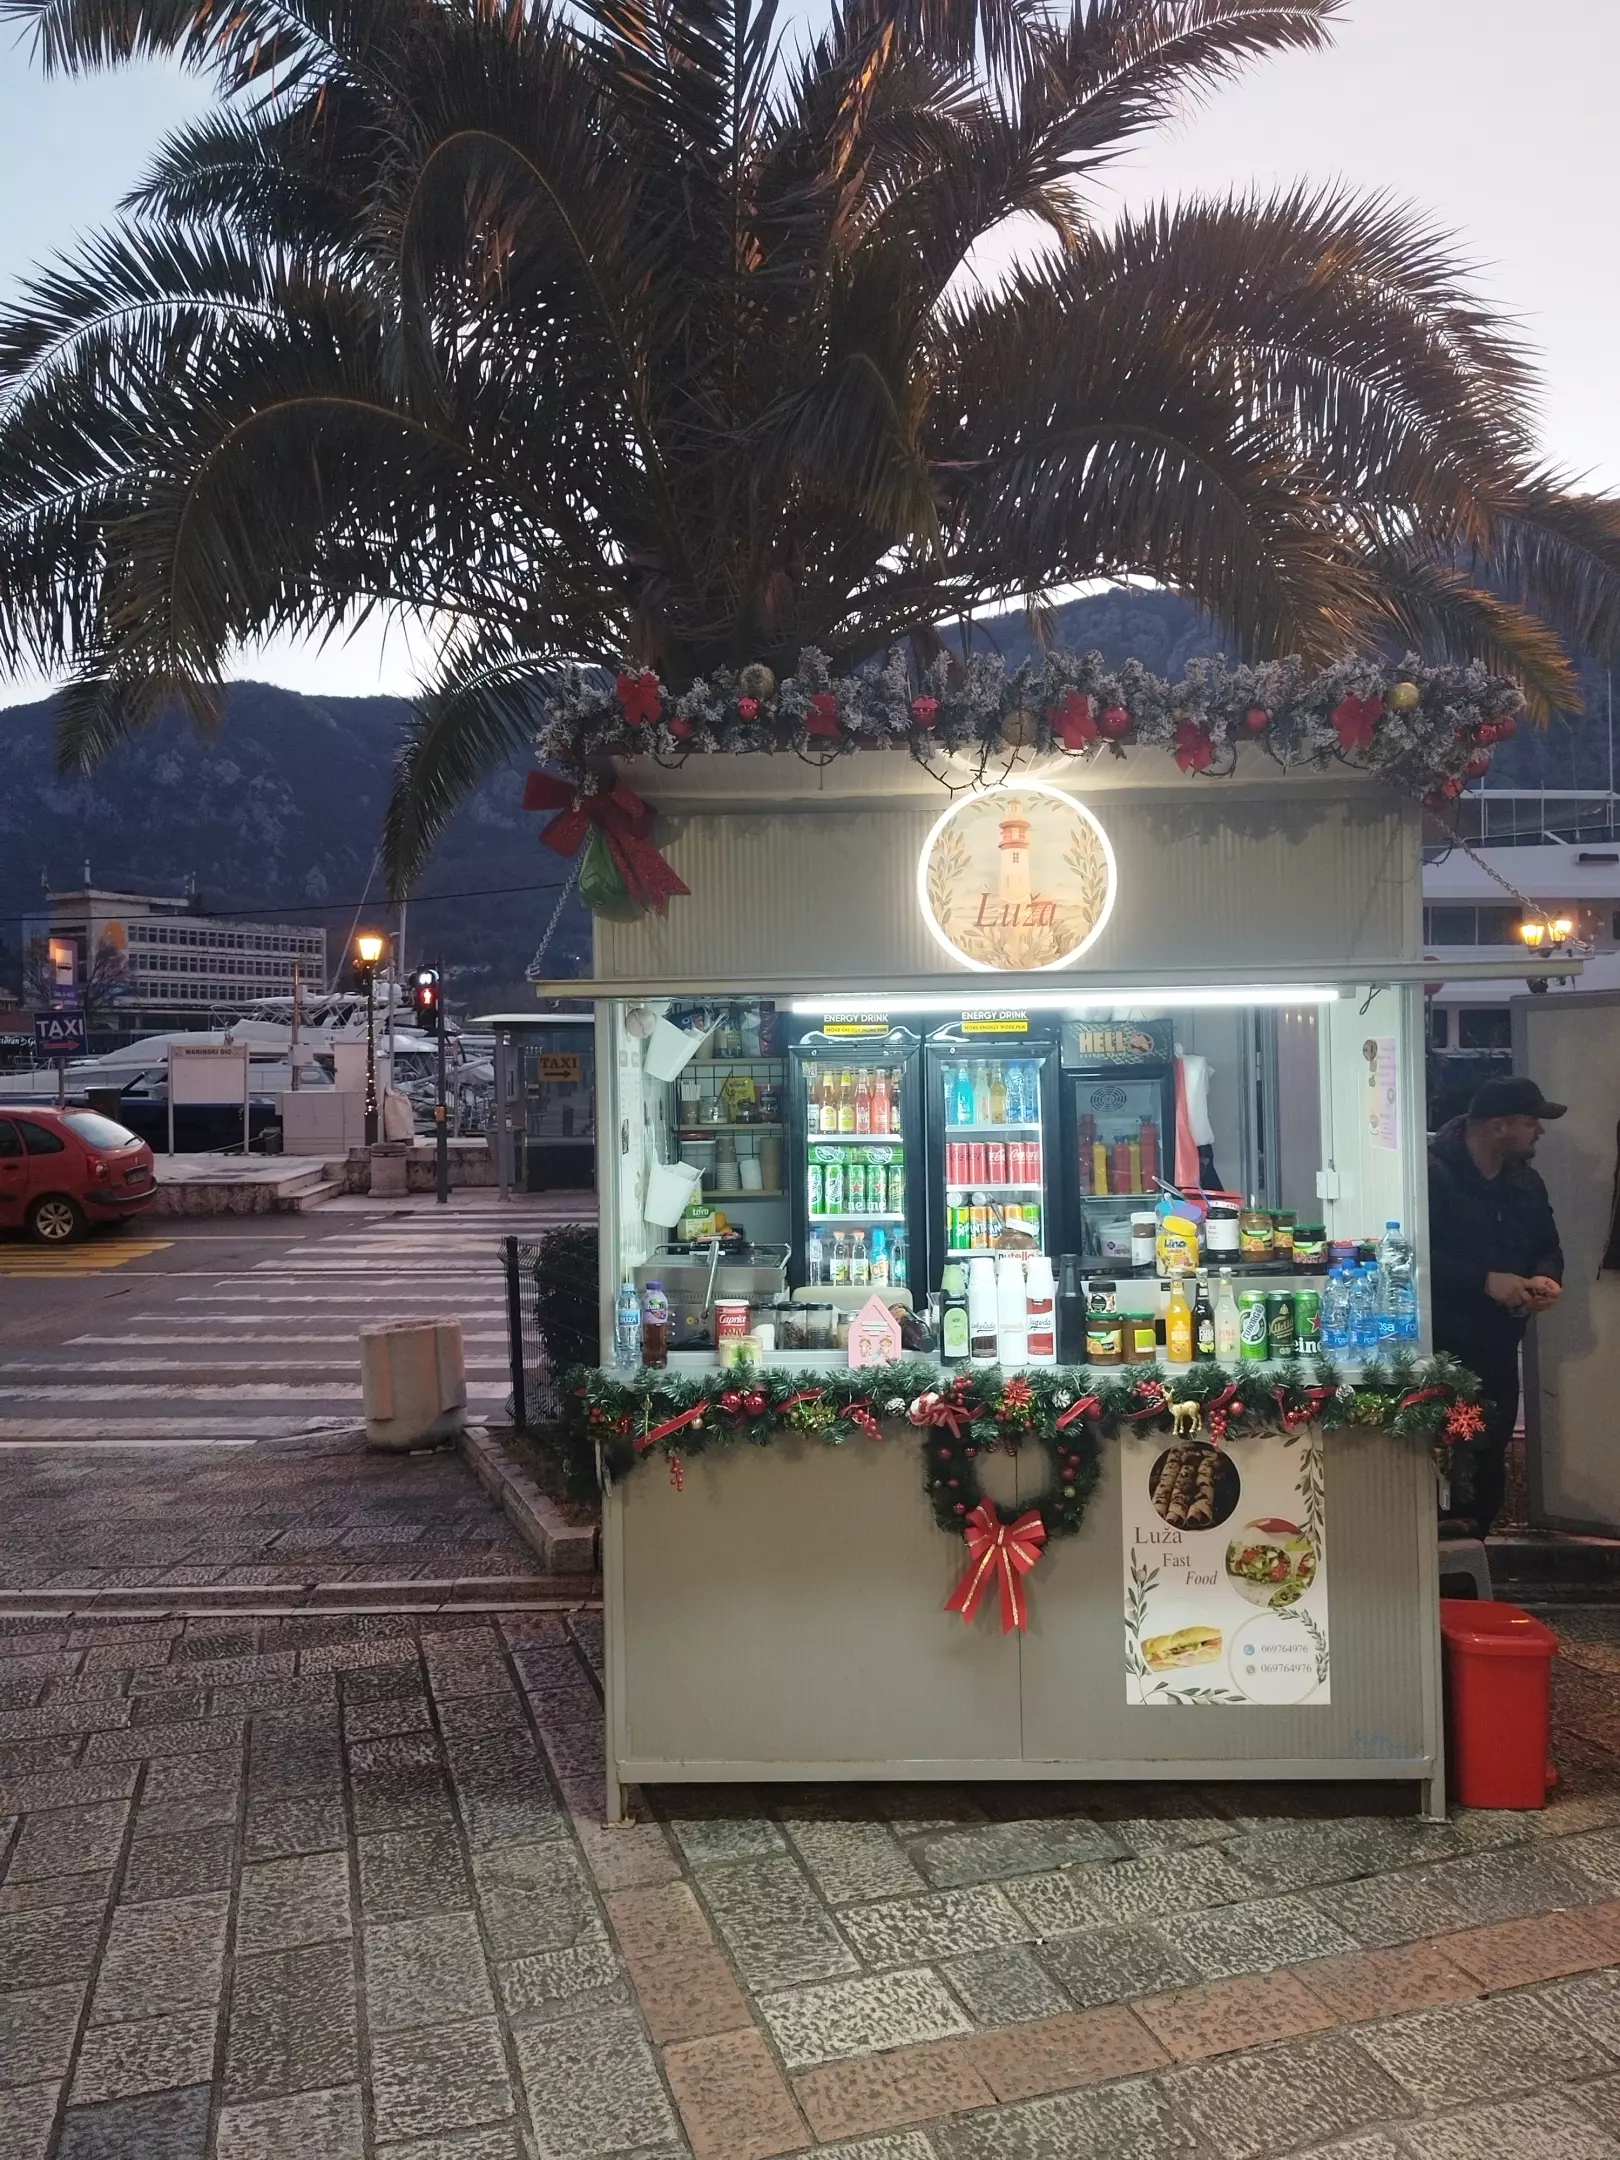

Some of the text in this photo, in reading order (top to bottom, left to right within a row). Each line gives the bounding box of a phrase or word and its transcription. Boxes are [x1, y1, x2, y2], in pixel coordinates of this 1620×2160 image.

[973, 892, 1058, 928] Luža
[823, 1014, 889, 1023] ENERGY DRINK
[961, 1010, 1028, 1020] ENERGY DRINK
[36, 1018, 84, 1037] TAXI
[1079, 1031, 1126, 1053] HELL
[540, 1057, 579, 1069] TAXI
[719, 1314, 747, 1324] Caprice
[1242, 1309, 1262, 1340] TUBORG
[1134, 1526, 1183, 1545] Luža
[1162, 1552, 1191, 1568] Fast
[1185, 1570, 1218, 1586] Food
[1261, 1644, 1308, 1653] 069764976
[1260, 1664, 1312, 1673] 069764976
